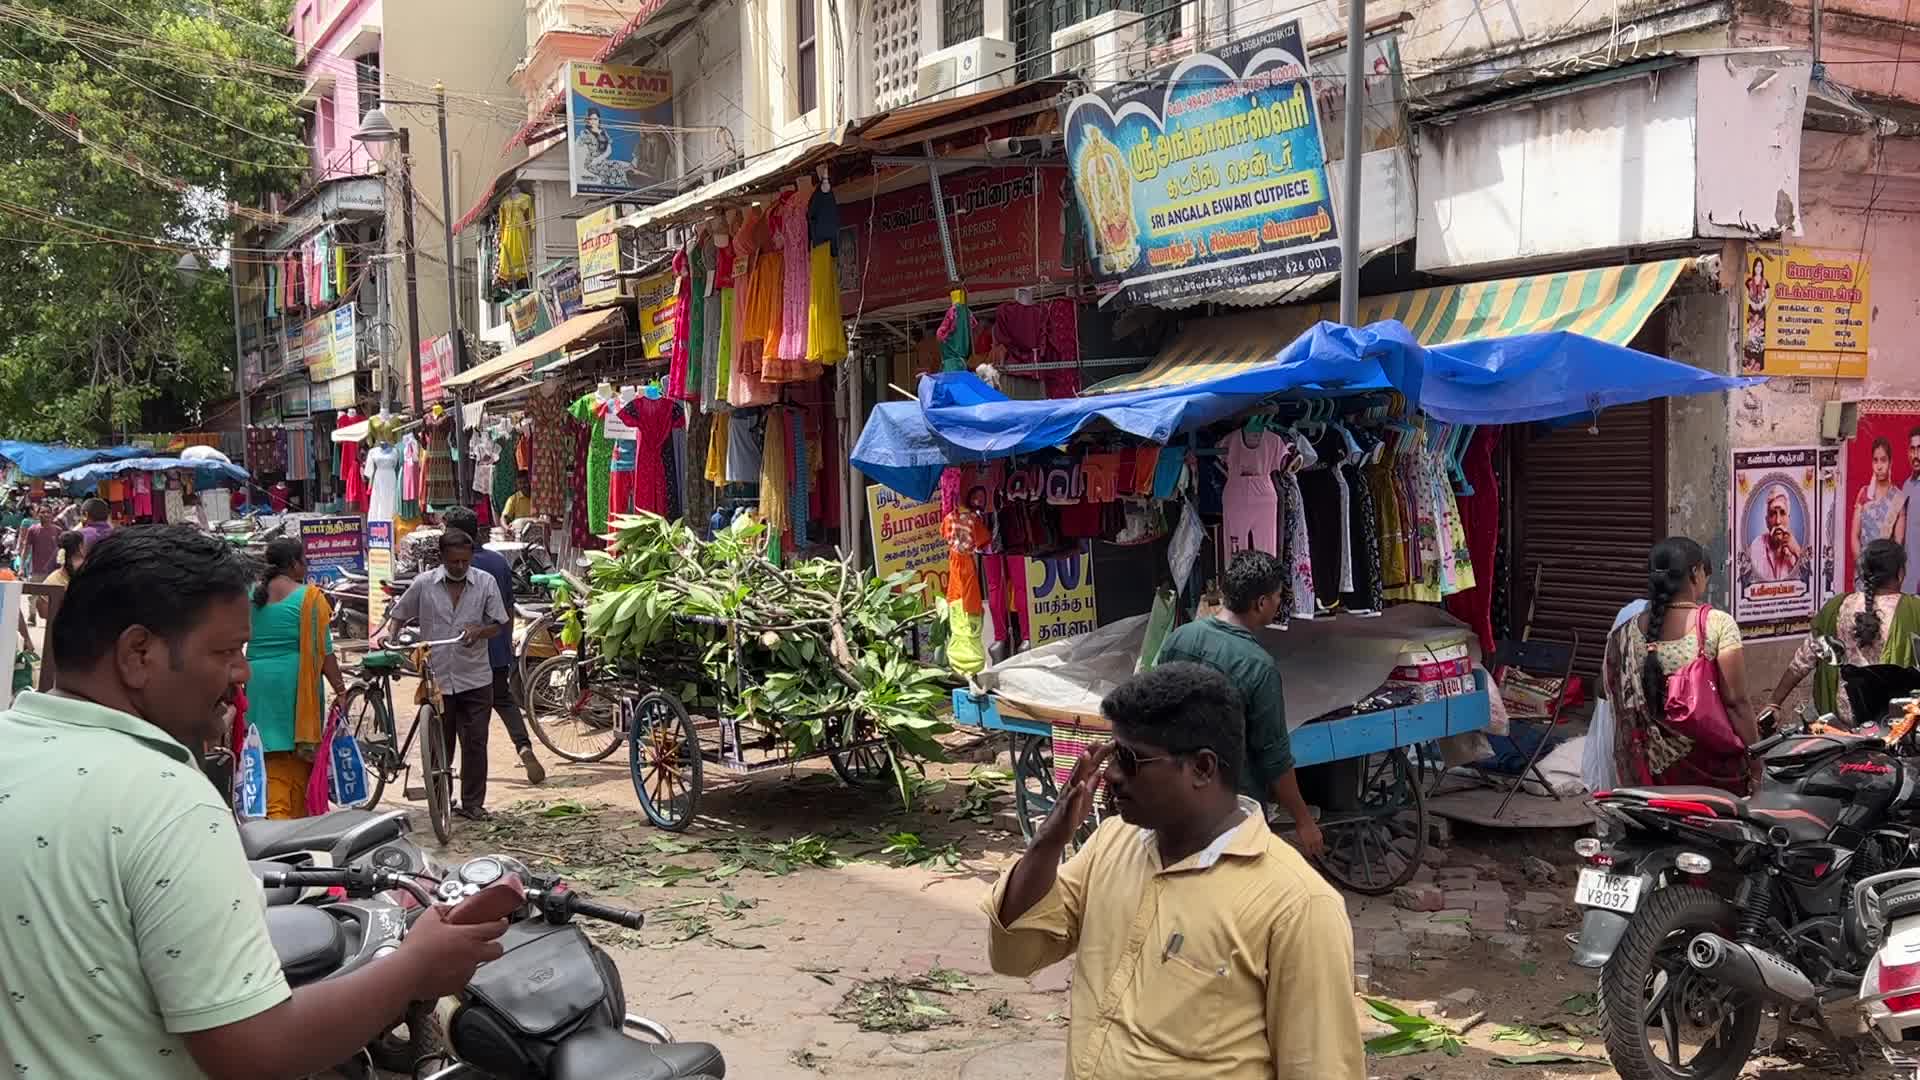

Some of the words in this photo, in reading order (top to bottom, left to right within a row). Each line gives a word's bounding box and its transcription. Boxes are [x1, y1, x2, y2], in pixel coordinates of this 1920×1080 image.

[578, 71, 668, 92] LAXMI
[1226, 140, 1294, 185] சென்டர்
[1151, 214, 1166, 230] SRI
[1168, 206, 1211, 226] ANGALA
[1213, 195, 1253, 216] ESWARI
[1254, 179, 1309, 206] CUTPIECE
[1597, 874, 1630, 893] TN64
[1587, 888, 1629, 909] V8097
